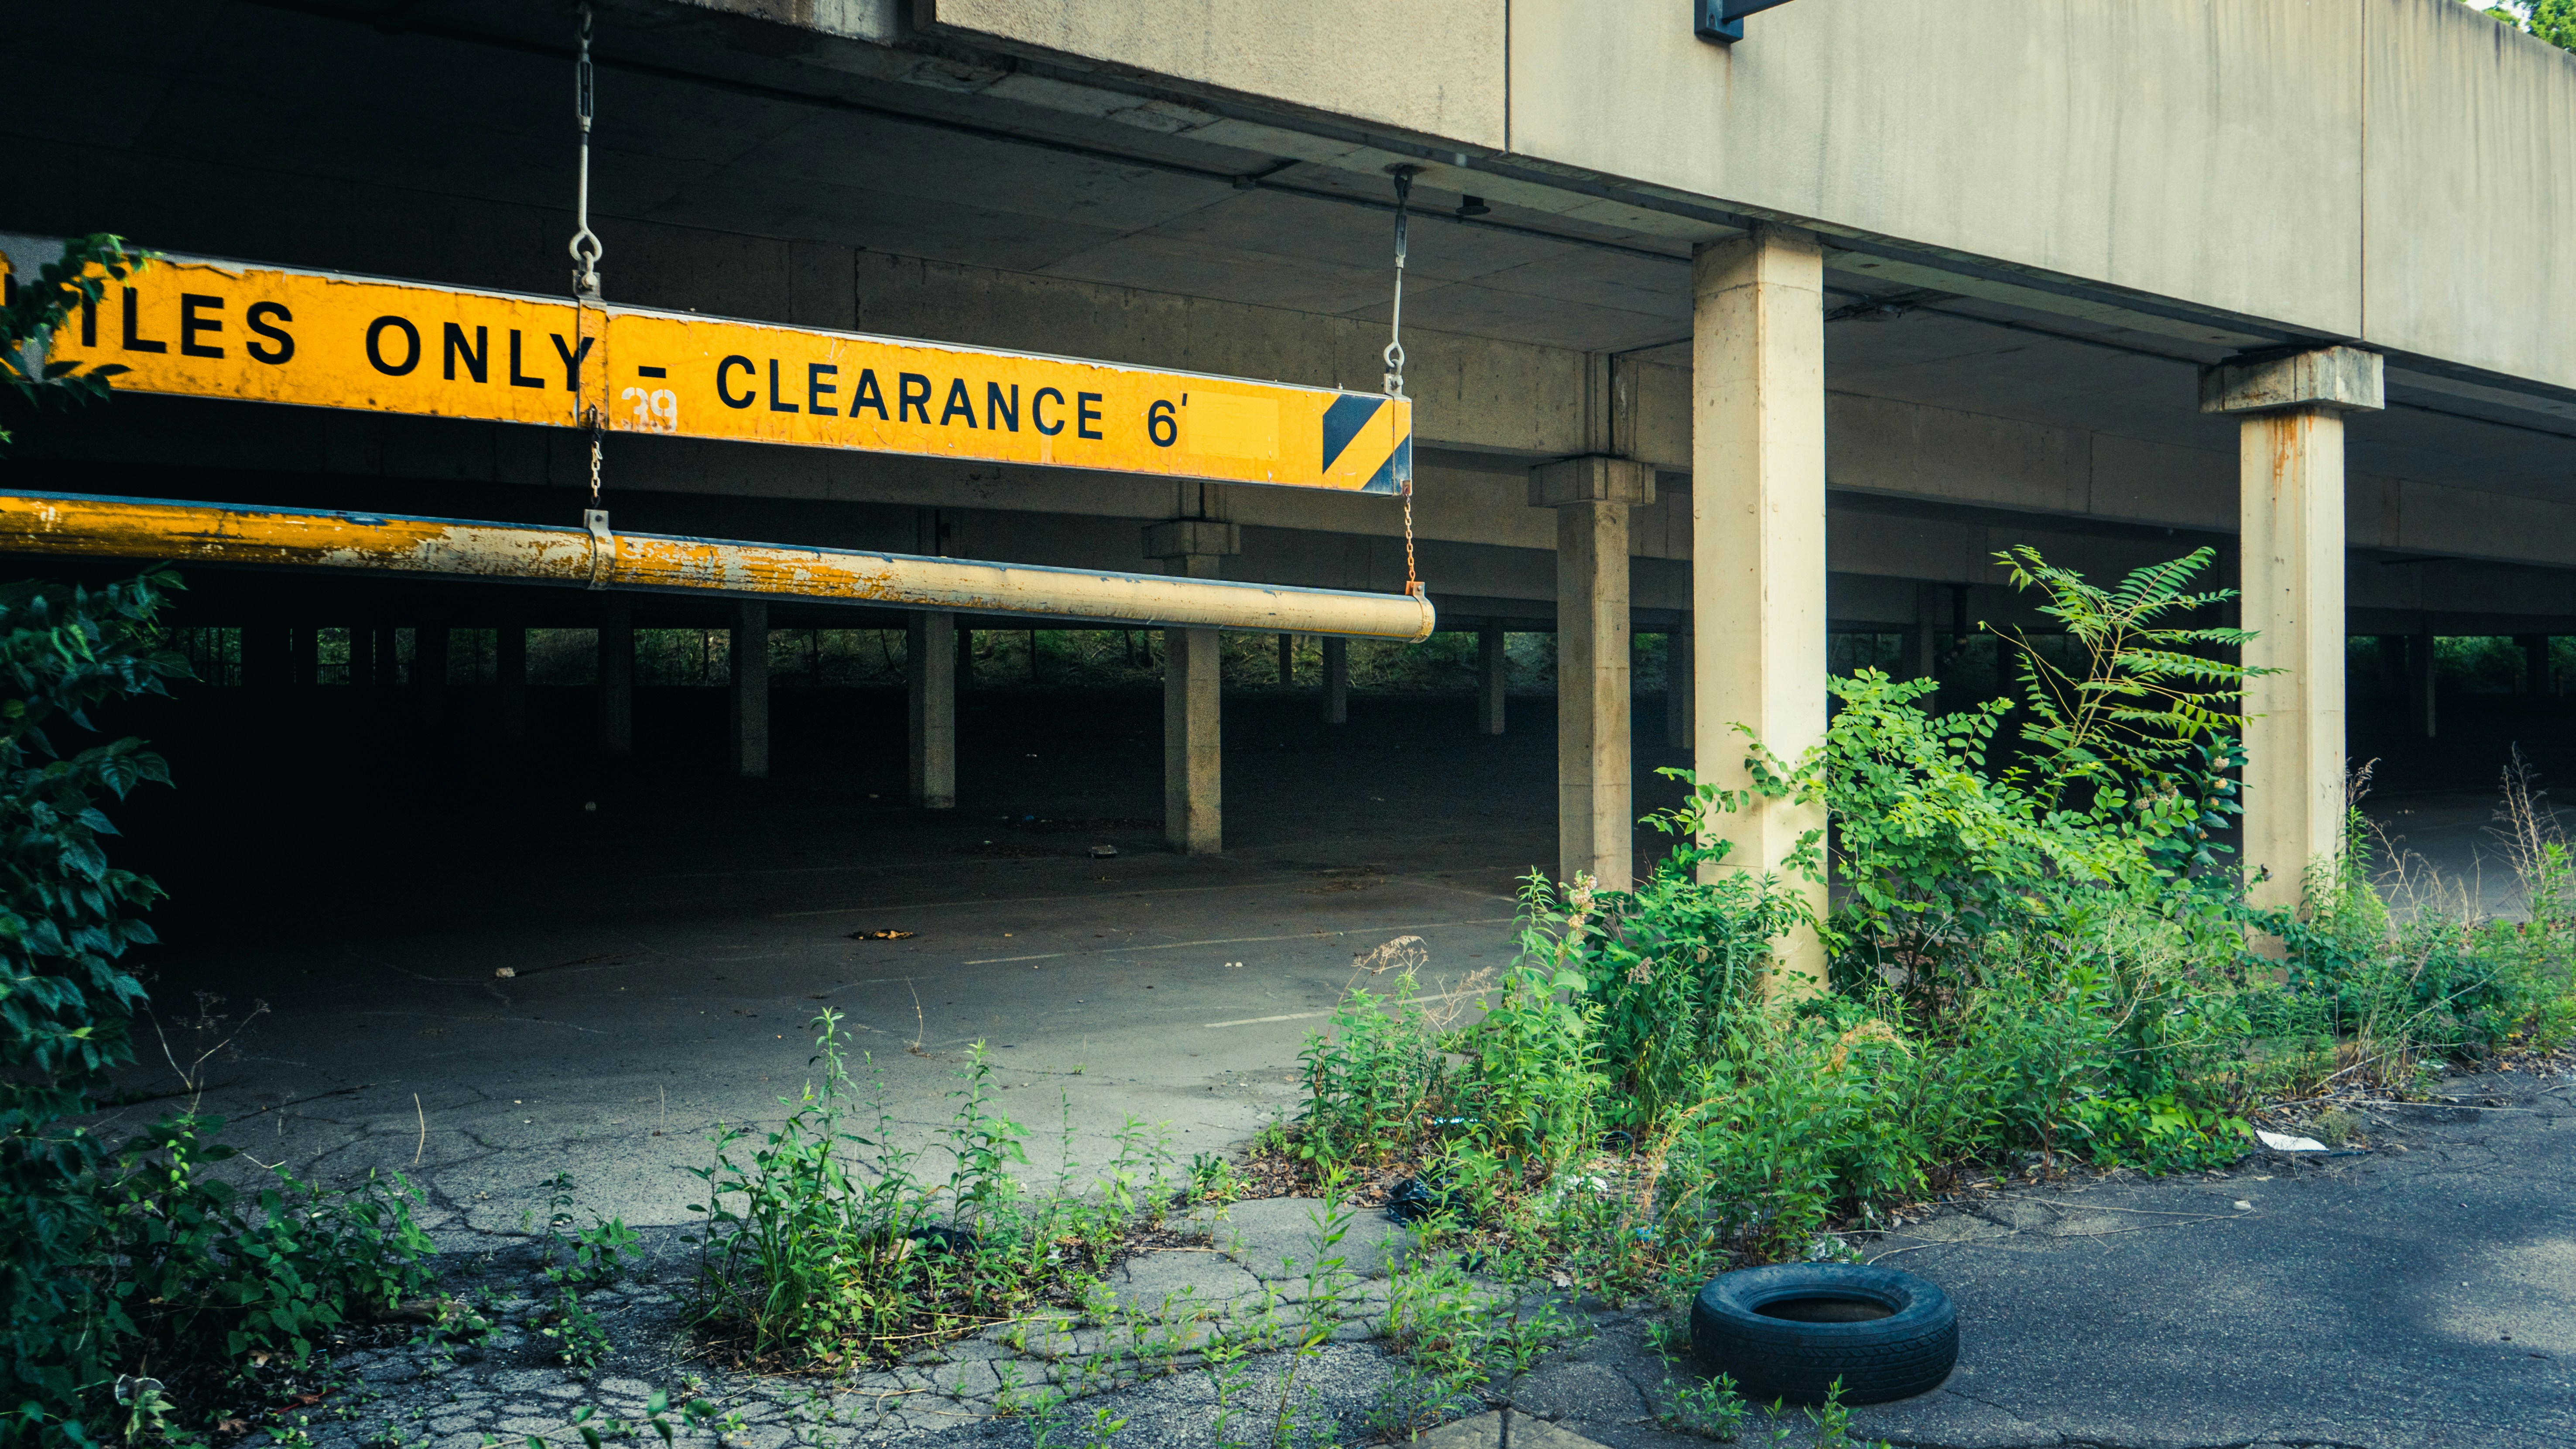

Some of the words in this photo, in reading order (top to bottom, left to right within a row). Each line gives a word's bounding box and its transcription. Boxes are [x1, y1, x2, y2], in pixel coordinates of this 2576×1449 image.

[366, 315, 595, 393] ONLY
[716, 355, 1103, 440] CLEARANCE
[621, 387, 677, 435] 39
